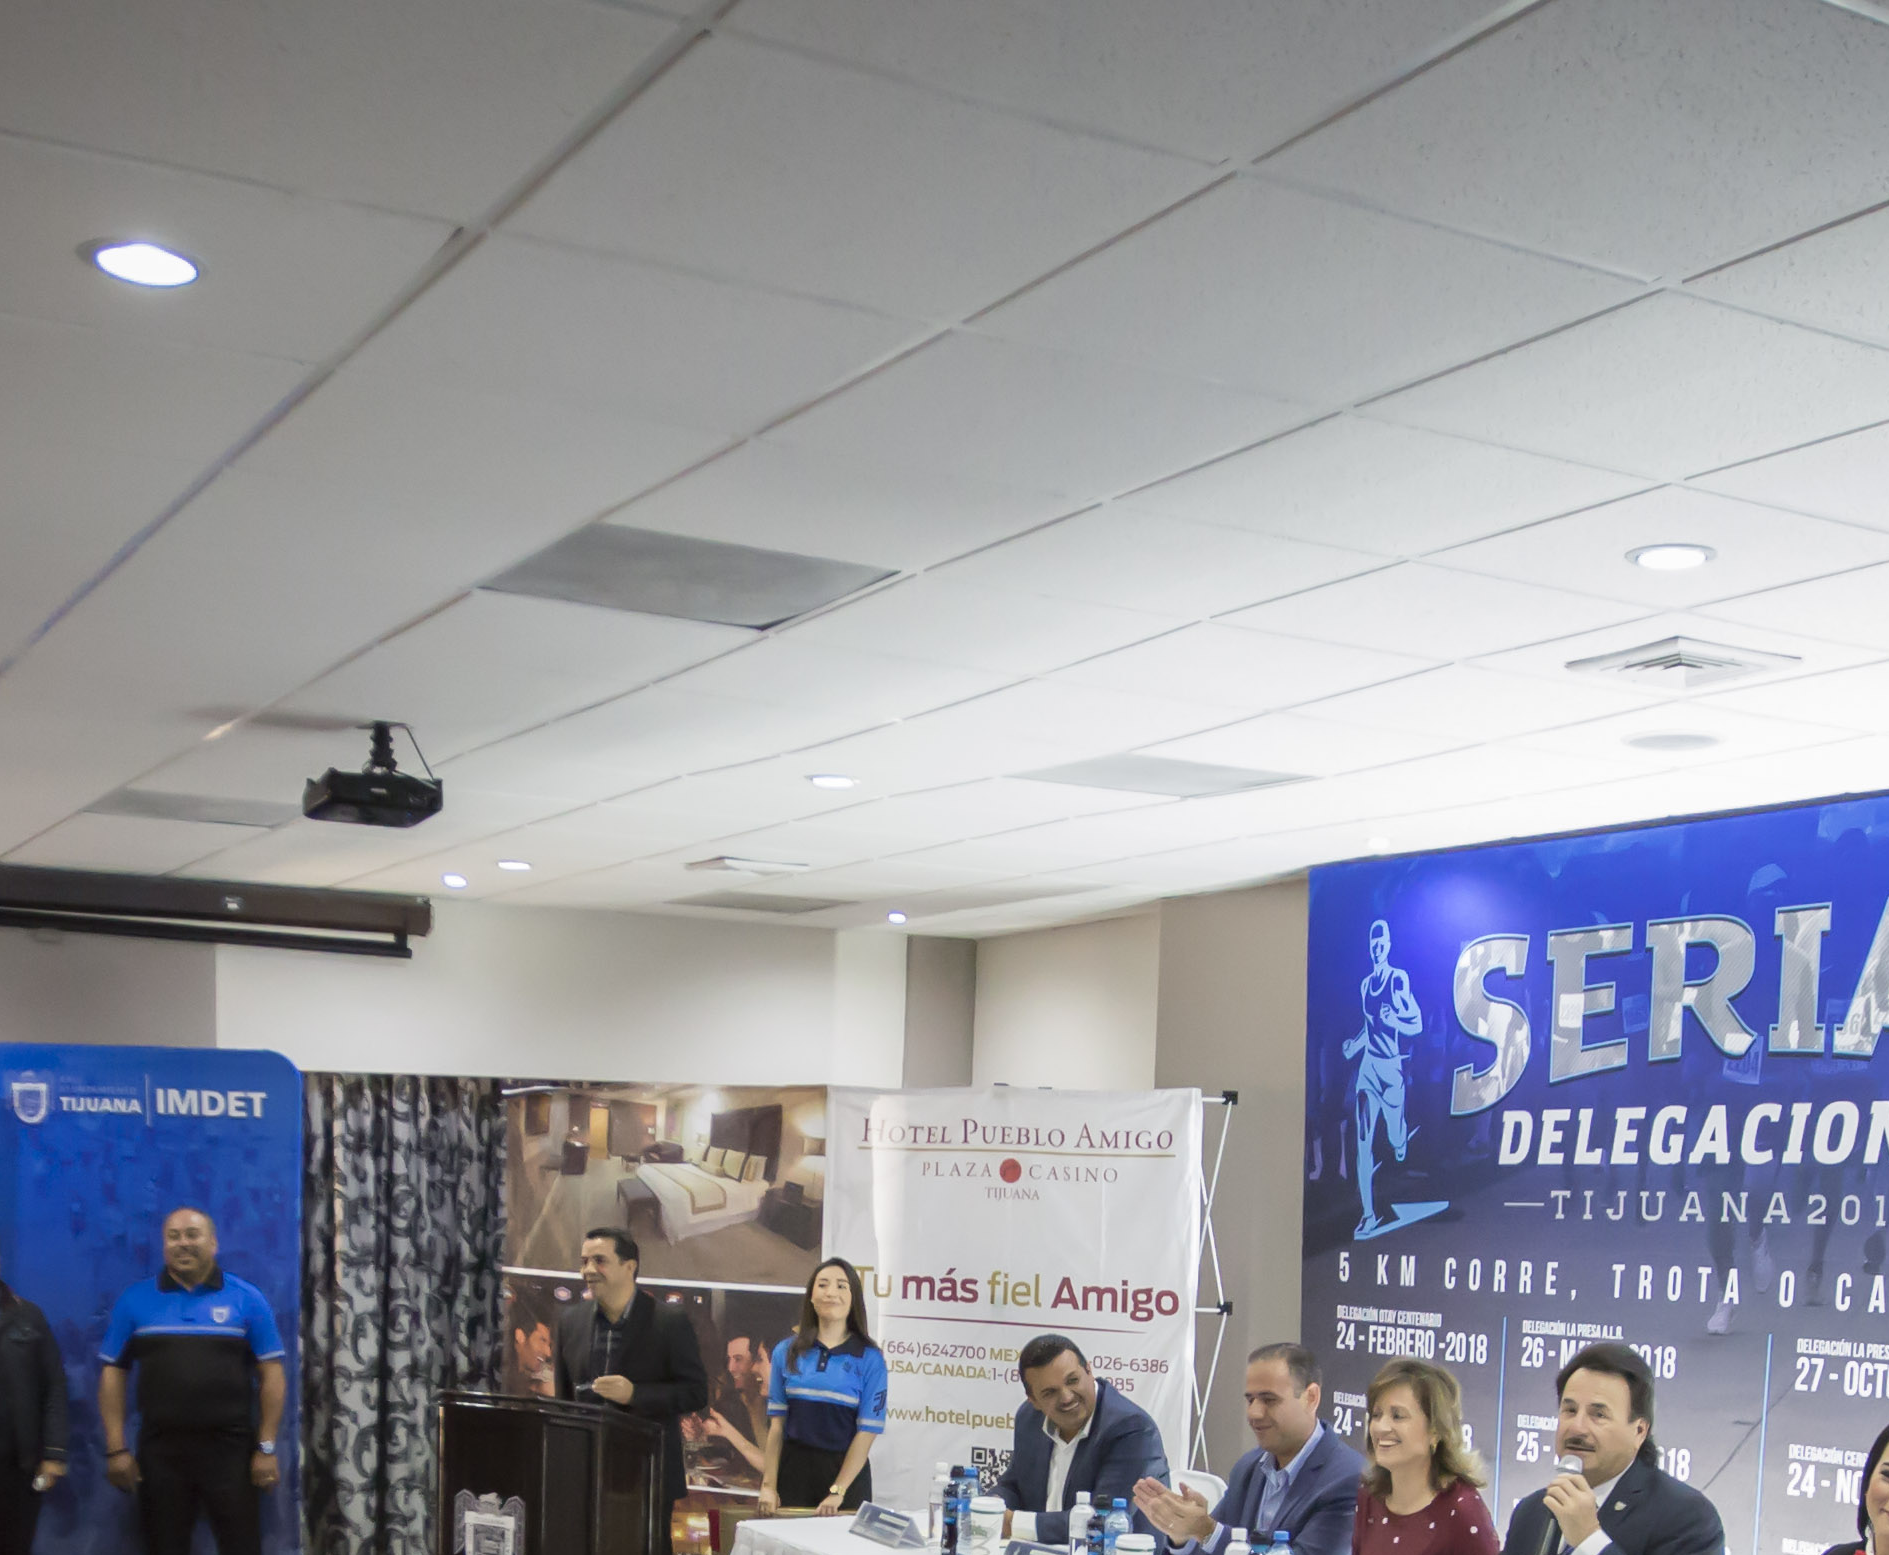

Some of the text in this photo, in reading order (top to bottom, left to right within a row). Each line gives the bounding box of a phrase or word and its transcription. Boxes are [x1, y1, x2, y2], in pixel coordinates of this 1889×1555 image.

[59, 1096, 143, 1115] TIJUANA
[155, 1087, 269, 1119] IMDET
[921, 1161, 1119, 1183] PLAZA CASINO
[984, 1186, 1041, 1201] TIJUANA
[901, 1266, 979, 1302] más
[987, 1270, 1042, 1309] fiel
[1050, 1276, 1180, 1322] Amigo
[1338, 1251, 1350, 1283] 5
[1376, 1254, 1417, 1287] KM
[1444, 1257, 1578, 1301] CORRE,
[1612, 1263, 1740, 1305] TROTA
[1778, 1270, 1796, 1309] O
[1337, 1304, 1442, 1328] DELEGACIÓN OTAY CENTENARIO
[1522, 1319, 1566, 1336] DELEGACIÓN
[1566, 1322, 1576, 1337] LA
[1577, 1323, 1601, 1338] PRESA
[1336, 1321, 1356, 1350] 24
[1368, 1325, 1436, 1359] FEBRERO
[1521, 1336, 1545, 1368] 26
[1796, 1338, 1851, 1358] DELEGACIÓN
[1852, 1342, 1865, 1358] LA
[1794, 1356, 1823, 1393] 27
[1333, 1406, 1353, 1436] 24
[1516, 1430, 1540, 1463] 25
[1788, 1443, 1843, 1465] DELEGACIÓN
[1787, 1461, 1816, 1499] 24
